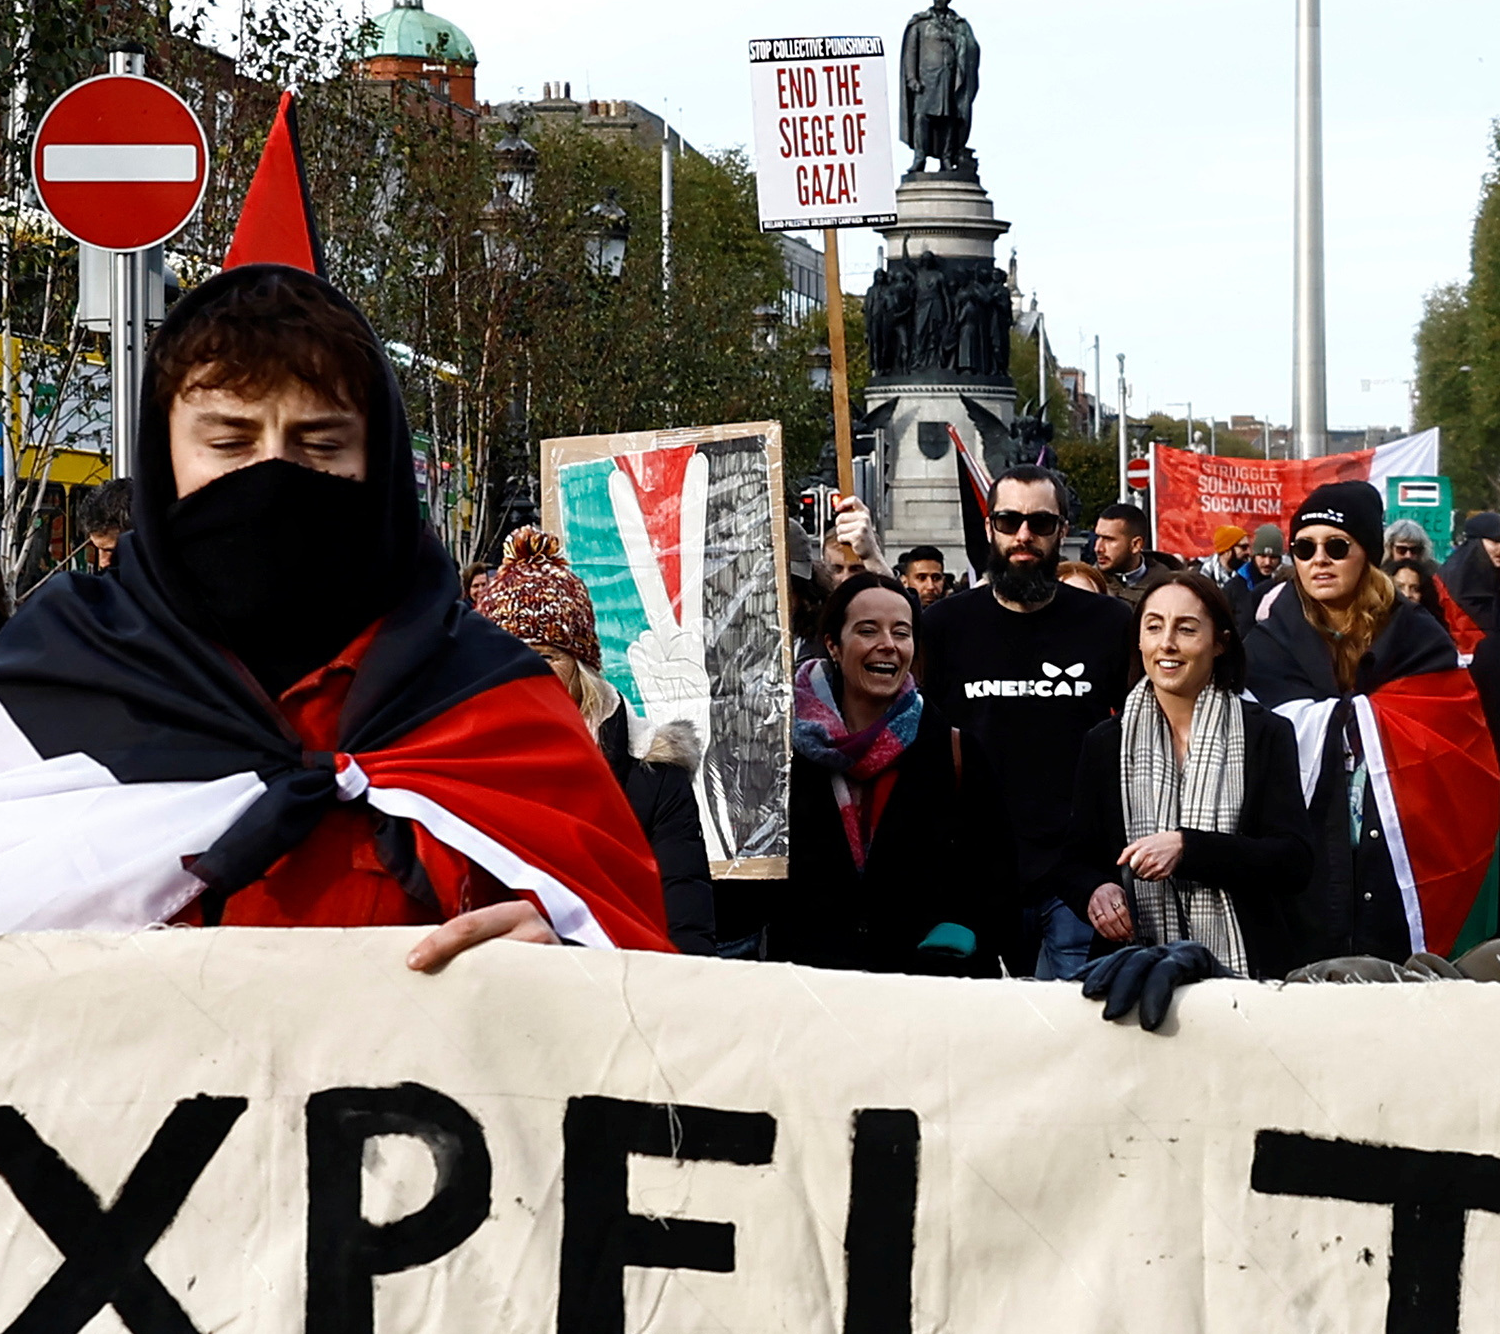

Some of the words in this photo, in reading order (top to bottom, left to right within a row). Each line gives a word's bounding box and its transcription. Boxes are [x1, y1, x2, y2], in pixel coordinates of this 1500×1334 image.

[750, 41, 771, 61] STOP
[773, 39, 824, 59] COLLECTIVE
[825, 37, 882, 57] PUNISHMENT
[776, 67, 817, 109] END
[822, 64, 863, 107] THE
[779, 115, 837, 158] SIEGE
[842, 113, 866, 155] OF
[796, 162, 858, 206] GAZA!
[1201, 462, 1278, 481] STRUGGLE
[1198, 474, 1282, 497] SOLIDARITY
[1201, 495, 1281, 515] SOCIALISM
[964, 680, 1092, 699] KNEECAP
